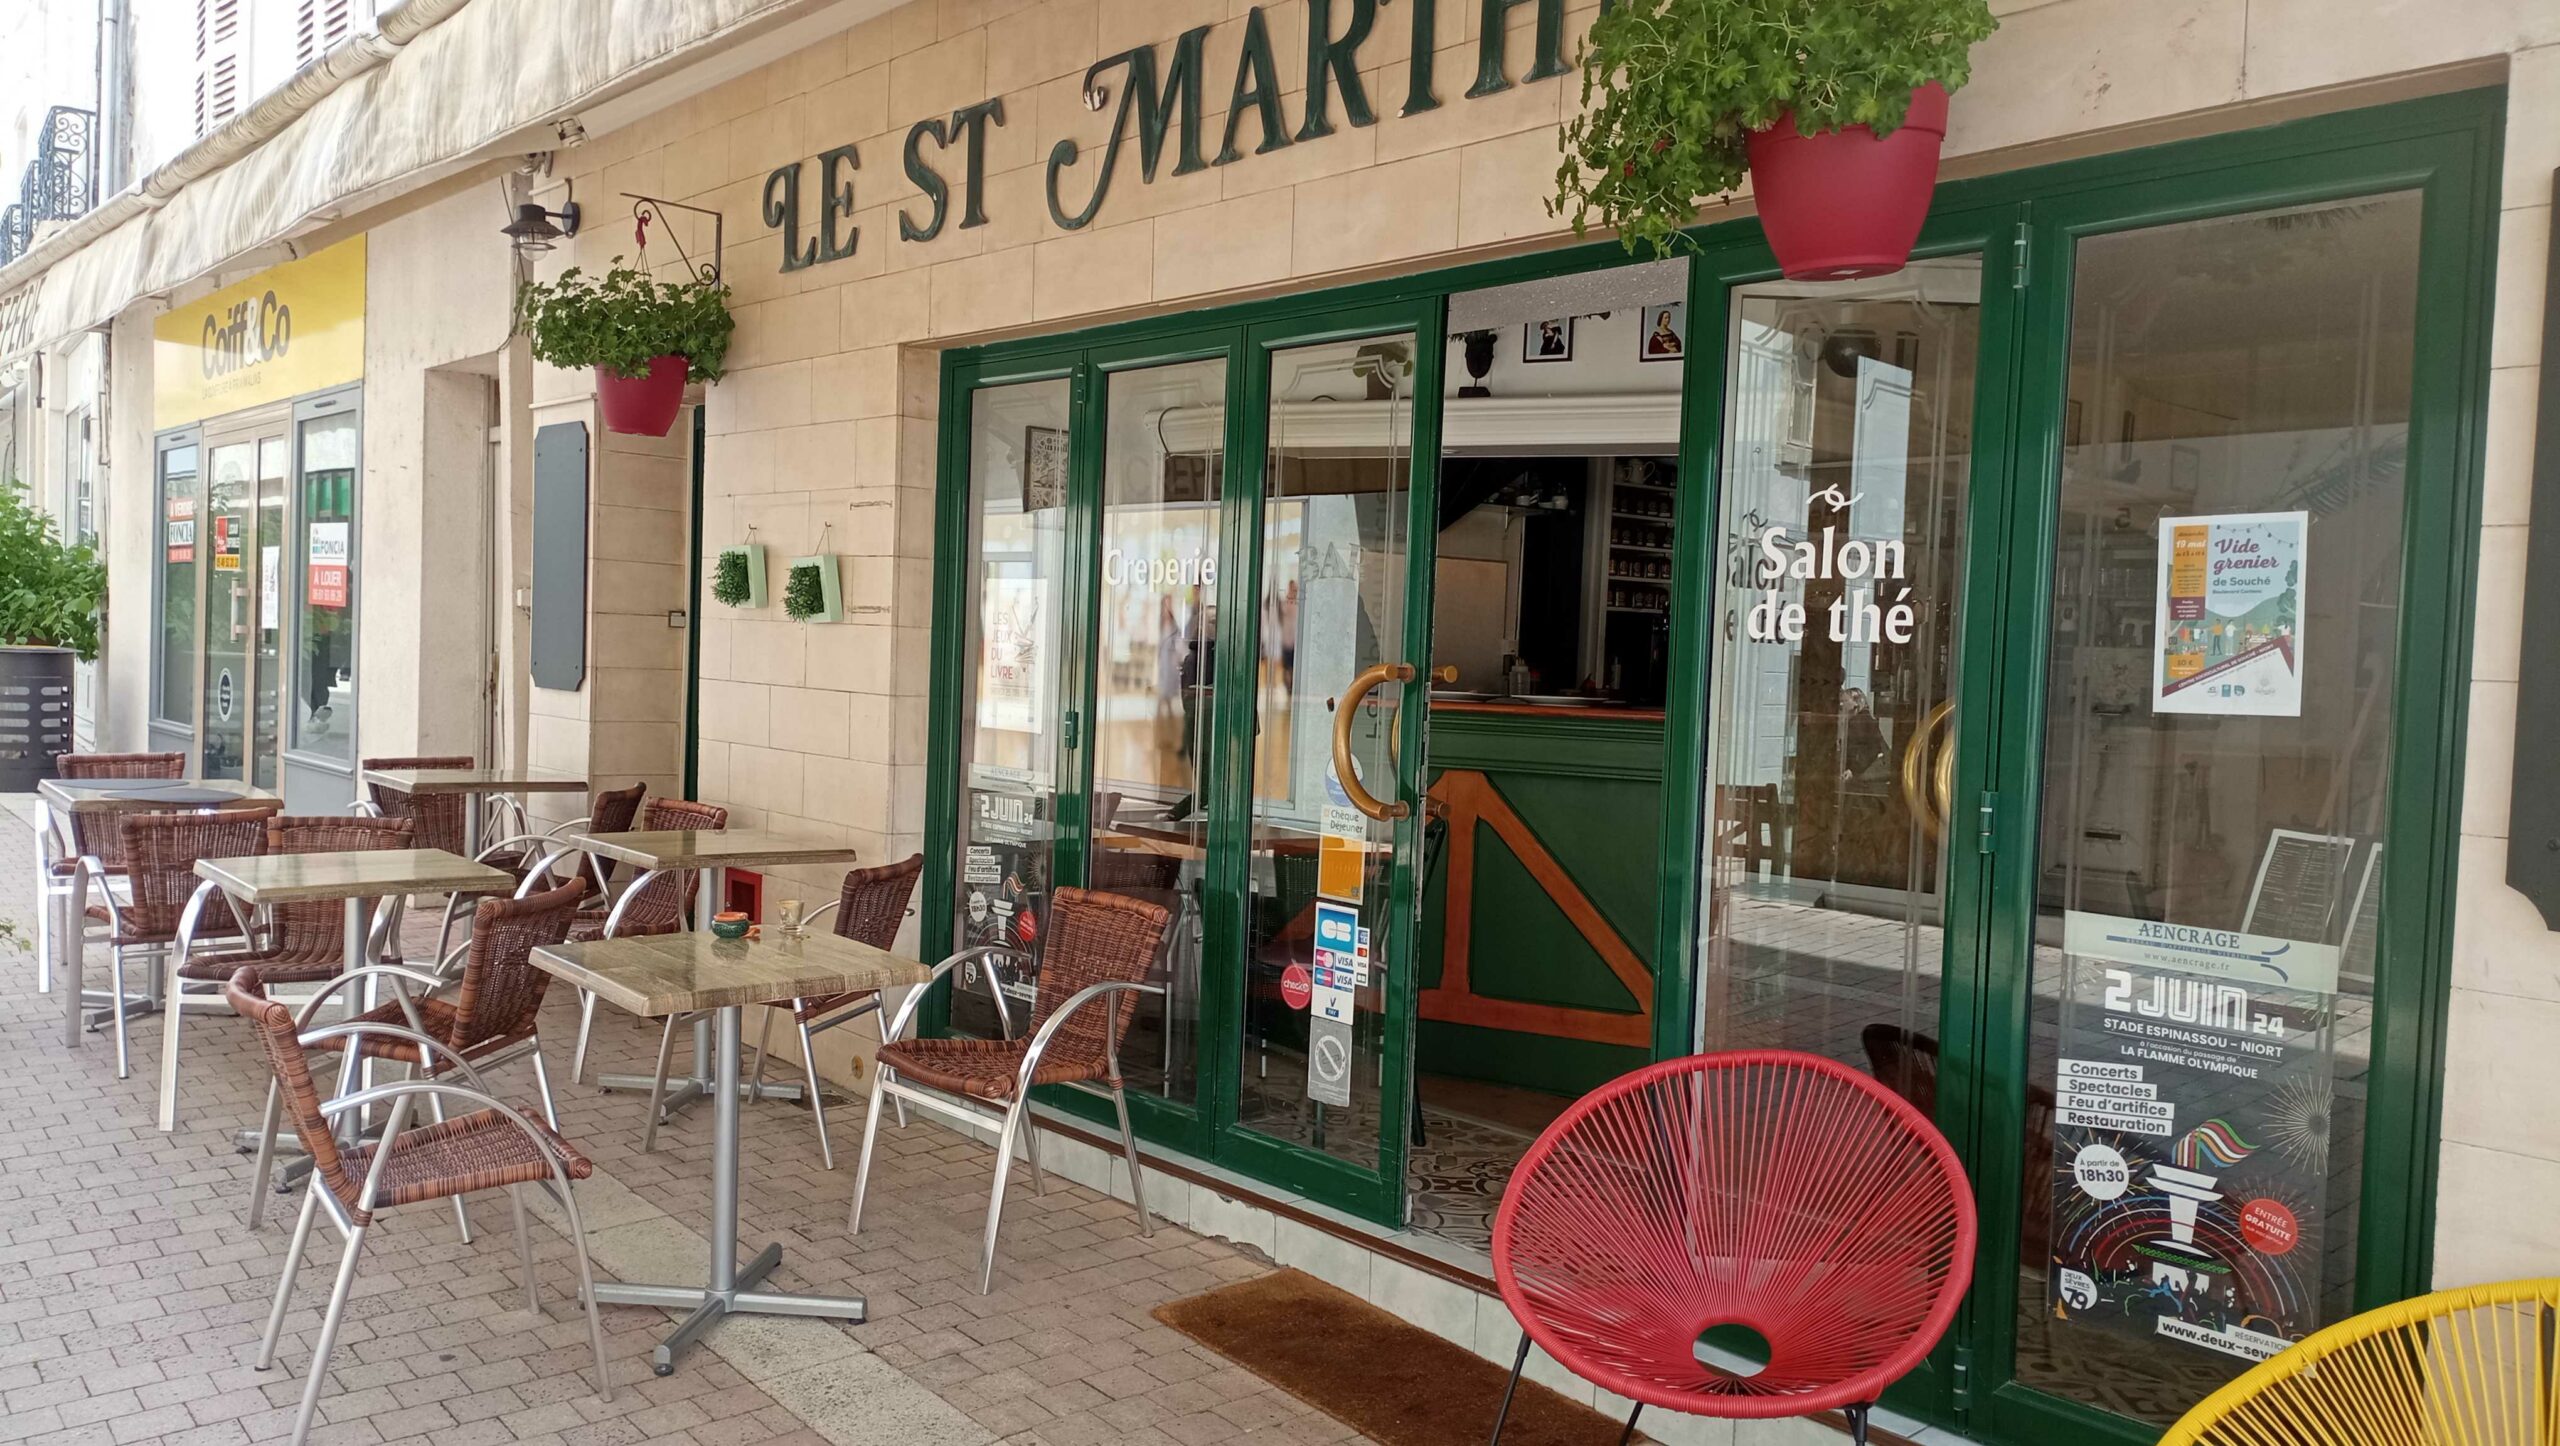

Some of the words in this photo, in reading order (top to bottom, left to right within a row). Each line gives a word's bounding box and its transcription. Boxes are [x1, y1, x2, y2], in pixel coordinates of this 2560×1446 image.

[763, 144, 860, 274] LE
[899, 97, 1004, 242] ST
[1045, 0, 1612, 231] MARTH
[203, 290, 290, 380] Coiff&Co
[321, 540, 345, 555] FONCIA
[1762, 525, 1905, 579] Salon
[2214, 538, 2261, 554] Vide
[1104, 547, 1217, 592] Creperie
[2213, 555, 2280, 576] grenier
[321, 570, 342, 587] LOUER
[2213, 577, 2227, 586] de
[2229, 576, 2271, 586] Souché
[1748, 588, 1806, 641] de
[1828, 587, 1914, 644] thé
[991, 647, 1003, 661] DU
[991, 665, 1014, 680] LIVRE
[981, 794, 990, 818] 2
[990, 796, 1023, 824] JUIN
[1024, 812, 1033, 826] 24
[1330, 808, 1359, 823] Chèque
[1330, 821, 1363, 834] Déjeuner
[1321, 919, 1352, 943] CB
[2139, 923, 2241, 949] AENCRAGE
[1337, 956, 1354, 968] VISA
[2144, 951, 2231, 972] www.aencrage.fr
[1336, 975, 1353, 986] VISA
[1330, 996, 1337, 1008] V
[2104, 968, 2133, 1013] 2
[2137, 975, 2248, 1032] JUIN
[2253, 1012, 2285, 1038] 24
[2104, 1017, 2144, 1035] STADE
[2146, 1022, 2228, 1048] ESPINASSOU
[2241, 1040, 2283, 1059] NIORT
[2121, 1045, 2135, 1057] LA
[2137, 1048, 2186, 1066] FLAMME
[2187, 1057, 2258, 1079] OLYMPIQUE
[2146, 1041, 2182, 1054] l'occasion
[2183, 1047, 2193, 1056] du
[2194, 1051, 2225, 1063] passage
[2226, 1055, 2237, 1063] de
[2070, 1063, 2137, 1079] Concerts
[2069, 1079, 2152, 1098] Spectacles
[2068, 1095, 2095, 1108] Feu
[2097, 1098, 2167, 1116] d'artifice
[2068, 1112, 2166, 1133] Restauration
[2087, 1160, 2108, 1169] partir
[2110, 1160, 2120, 1168] de
[2079, 1169, 2125, 1182] 18h30
[2245, 1214, 2291, 1241] GRATUITE
[2255, 1207, 2288, 1228] ENTRÉE
[2065, 1272, 2082, 1281] DEUX
[2064, 1286, 2089, 1311] 79
